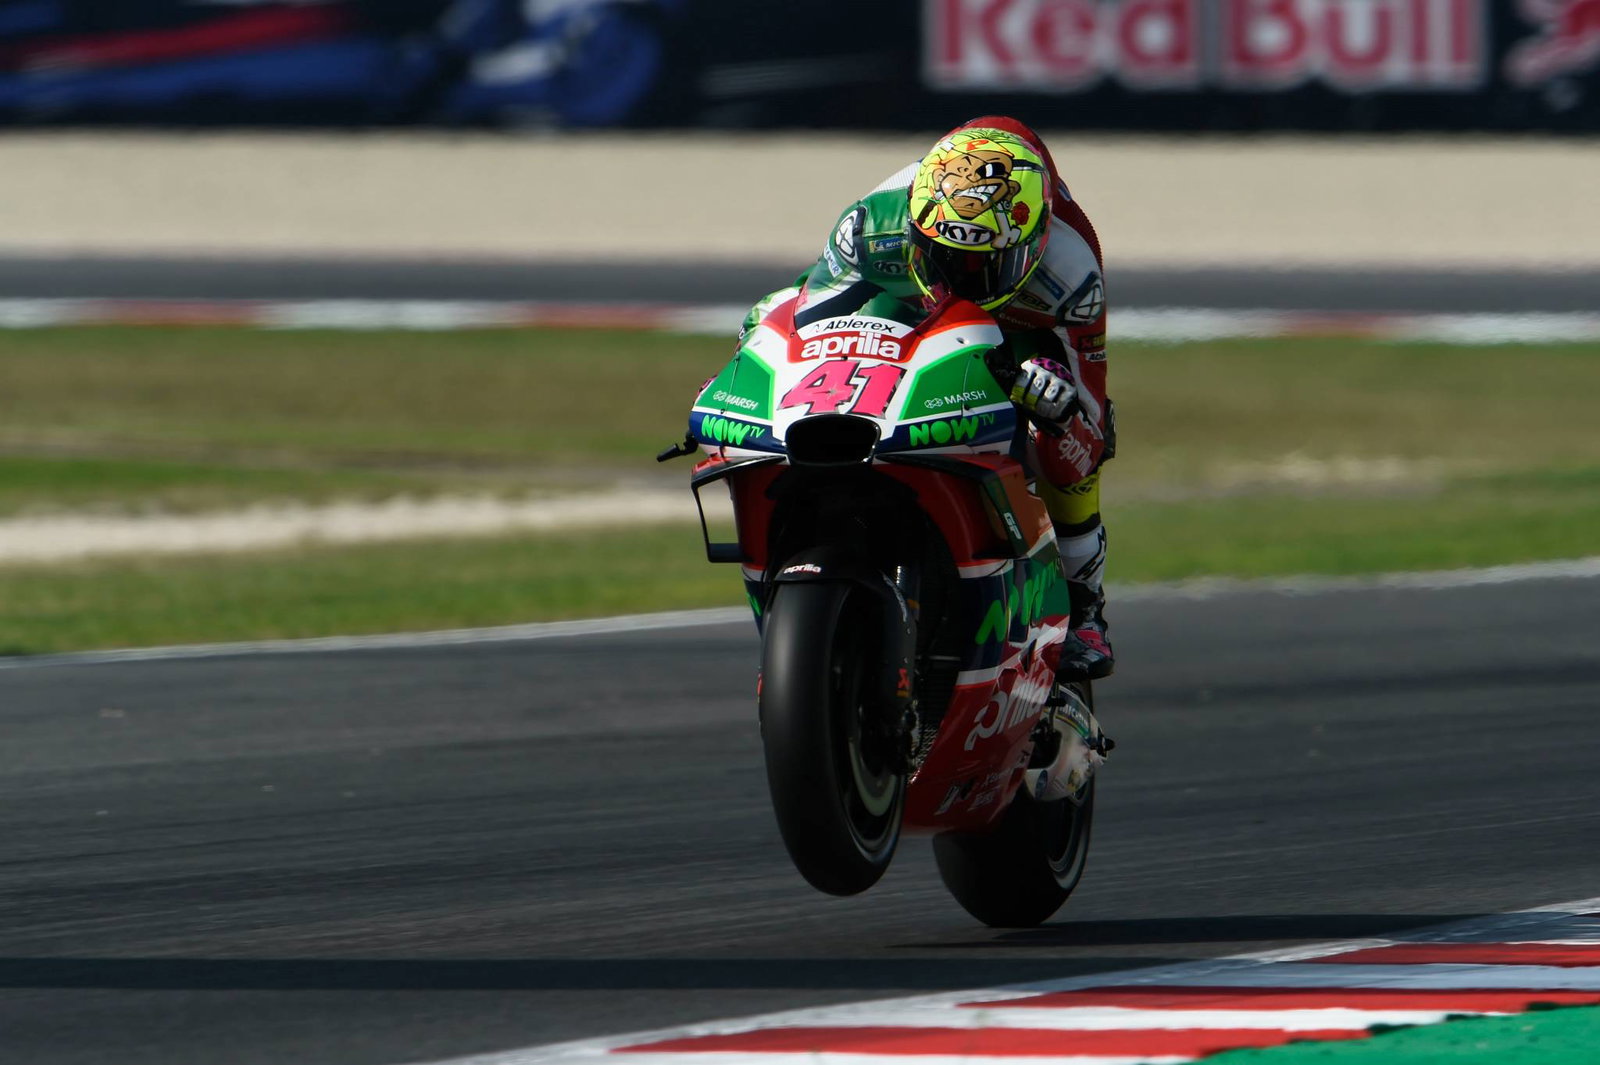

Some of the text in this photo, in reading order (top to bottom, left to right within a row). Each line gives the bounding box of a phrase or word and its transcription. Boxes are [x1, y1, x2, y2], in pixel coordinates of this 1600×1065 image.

[928, 0, 1482, 85] Red Bull
[936, 221, 993, 244] KYT
[823, 318, 897, 333] Ablerex
[800, 330, 901, 360] aprilia
[725, 394, 759, 411] MARSH
[776, 359, 908, 419] 41
[943, 389, 987, 405] MARSH
[701, 414, 765, 446] NOW TV
[909, 412, 995, 447] NOW TV
[1003, 512, 1022, 540] GP
[783, 563, 822, 574] aprilia
